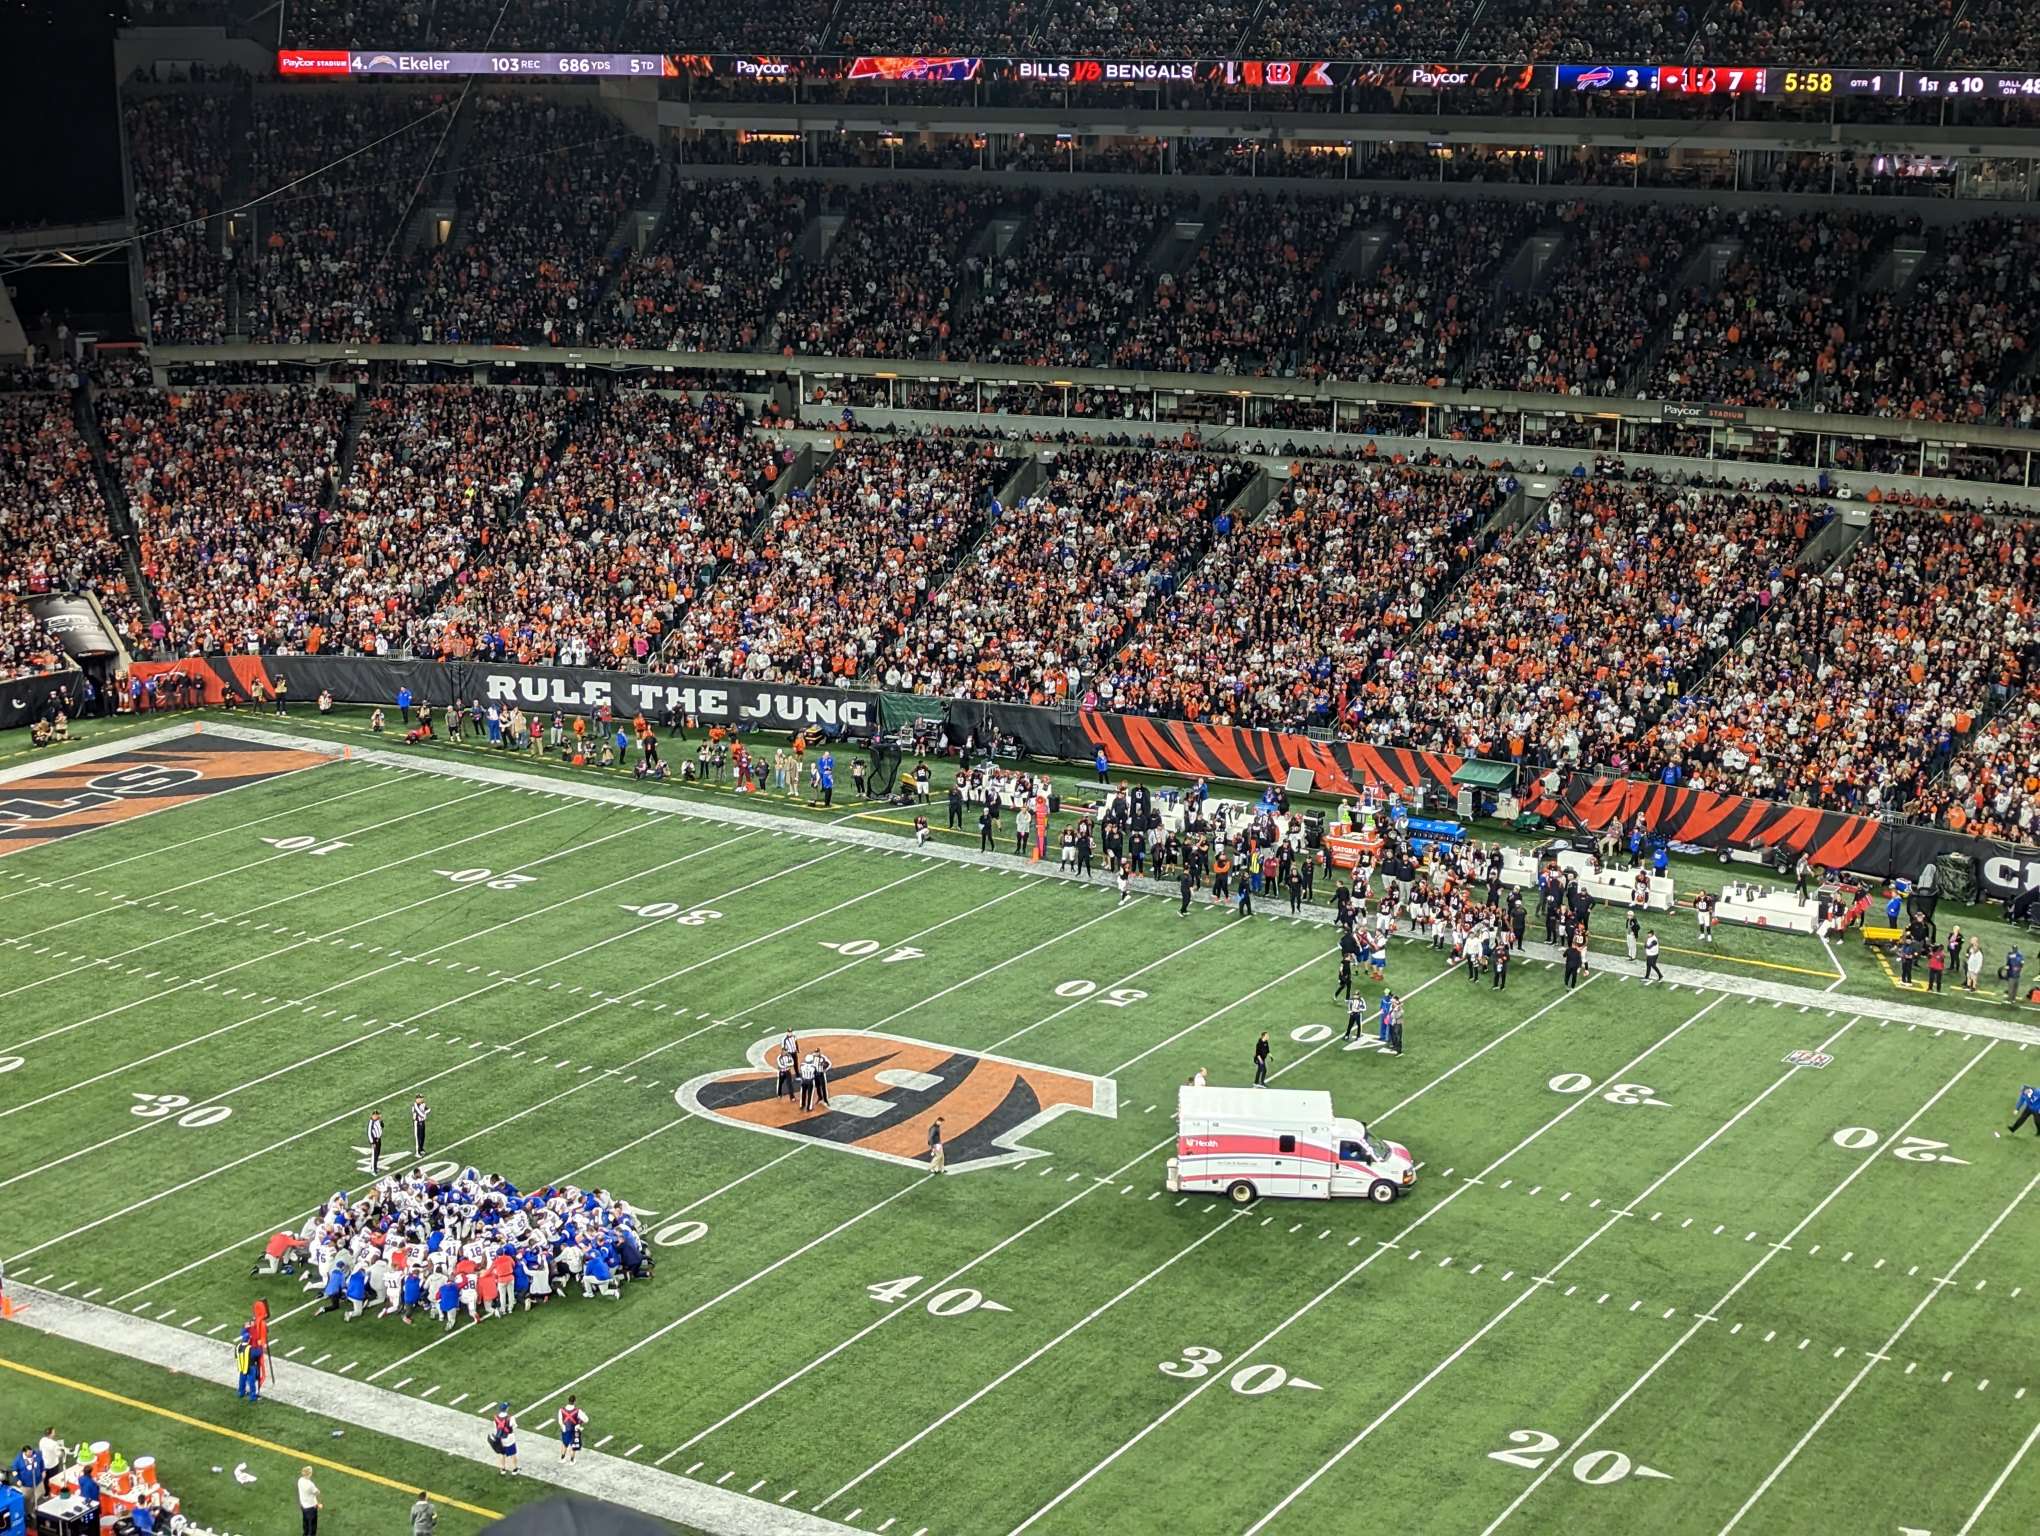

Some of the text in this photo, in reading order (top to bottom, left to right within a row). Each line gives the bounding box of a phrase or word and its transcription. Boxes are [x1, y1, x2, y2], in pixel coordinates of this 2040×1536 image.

[283, 58, 314, 69] Paycor
[351, 56, 654, 73] 4. Ekeler 103 REC 686 YDS 5 TD
[737, 60, 789, 77] Paycor
[1020, 63, 1070, 77] BILLS
[1106, 64, 1193, 79] BENGALS
[1412, 69, 1469, 87] Paycor
[1625, 70, 1639, 88] 3
[1728, 71, 1744, 91] 7
[1784, 72, 1833, 92] 5:58
[1871, 75, 1881, 91] 1
[1918, 76, 1984, 93] 1ST & 10
[1998, 80, 2021, 88] BALL
[2003, 87, 2017, 95] ON
[1664, 404, 1744, 420] Paycor STADIUM
[486, 674, 612, 706] RULE
[631, 684, 728, 715] THE
